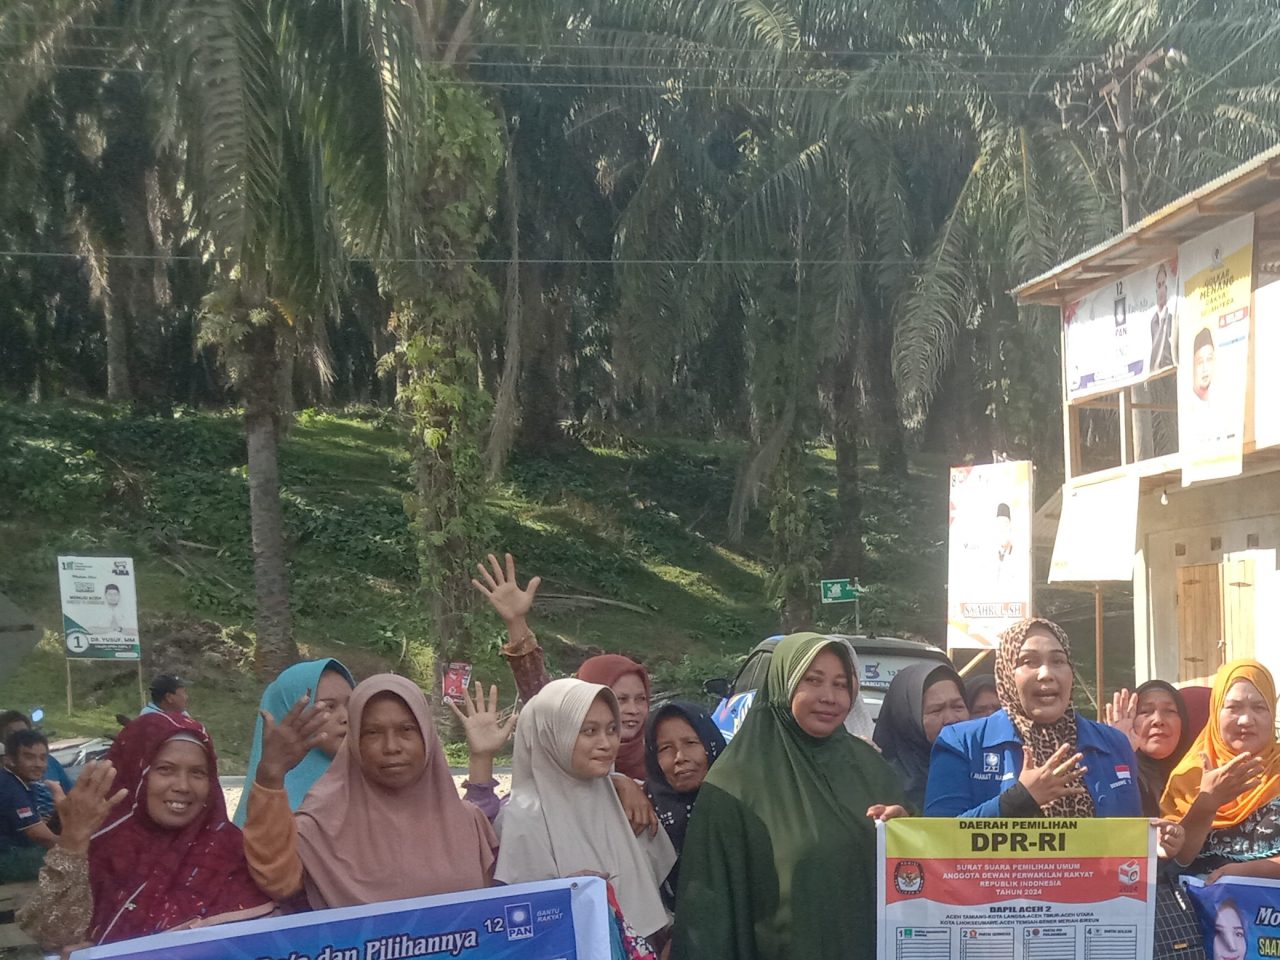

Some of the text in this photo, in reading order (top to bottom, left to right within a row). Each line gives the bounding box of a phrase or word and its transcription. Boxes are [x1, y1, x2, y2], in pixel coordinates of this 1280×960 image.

[1115, 281, 1124, 295] 12
[1115, 327, 1128, 336] PAN
[73, 636, 83, 649] 1
[959, 820, 1078, 830] DAERAH PEMILIHAN
[971, 832, 1066, 852] DPR-RI
[484, 918, 532, 938] 12 PAN
